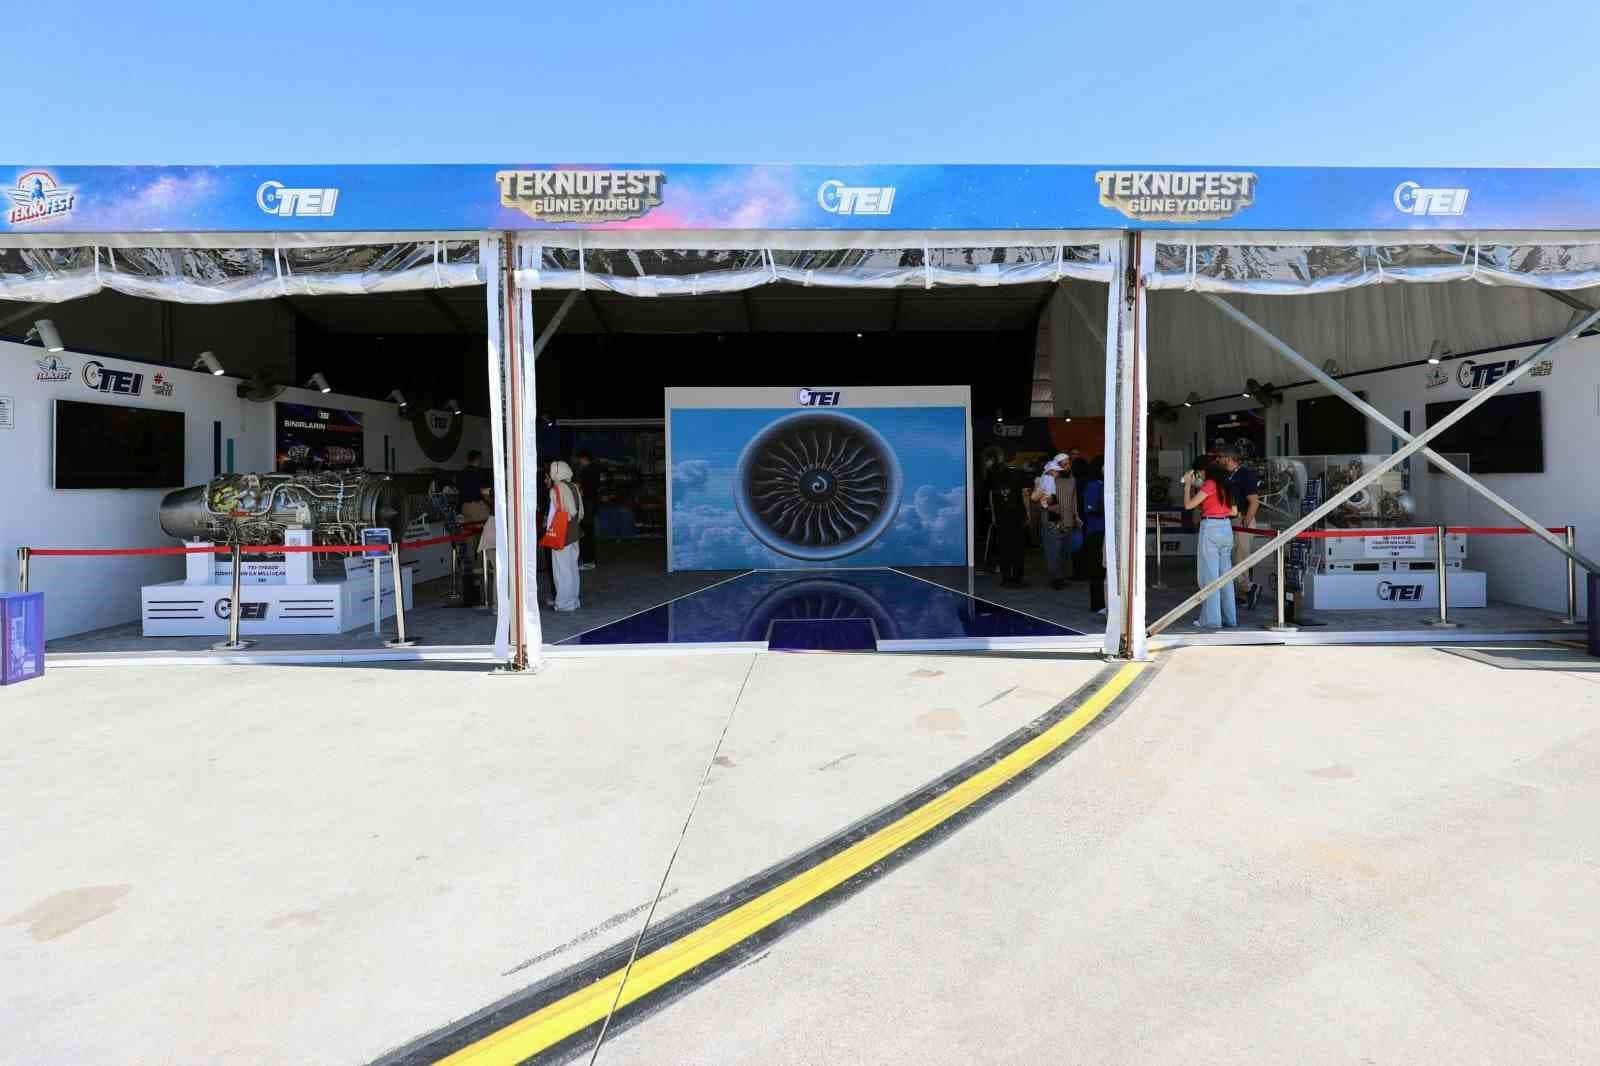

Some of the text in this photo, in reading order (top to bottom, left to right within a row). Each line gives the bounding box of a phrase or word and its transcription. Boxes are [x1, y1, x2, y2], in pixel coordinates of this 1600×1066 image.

[496, 171, 666, 195] TEKNOFEST
[1096, 171, 1257, 195] TEKNOFEST
[9, 195, 75, 223] TEKNOFEST
[276, 187, 338, 216] TEI
[836, 187, 896, 214] TEI
[1411, 188, 1469, 215] TEI
[98, 369, 144, 396] TEI
[808, 391, 840, 405] TEI
[1388, 585, 1424, 600] TEI
